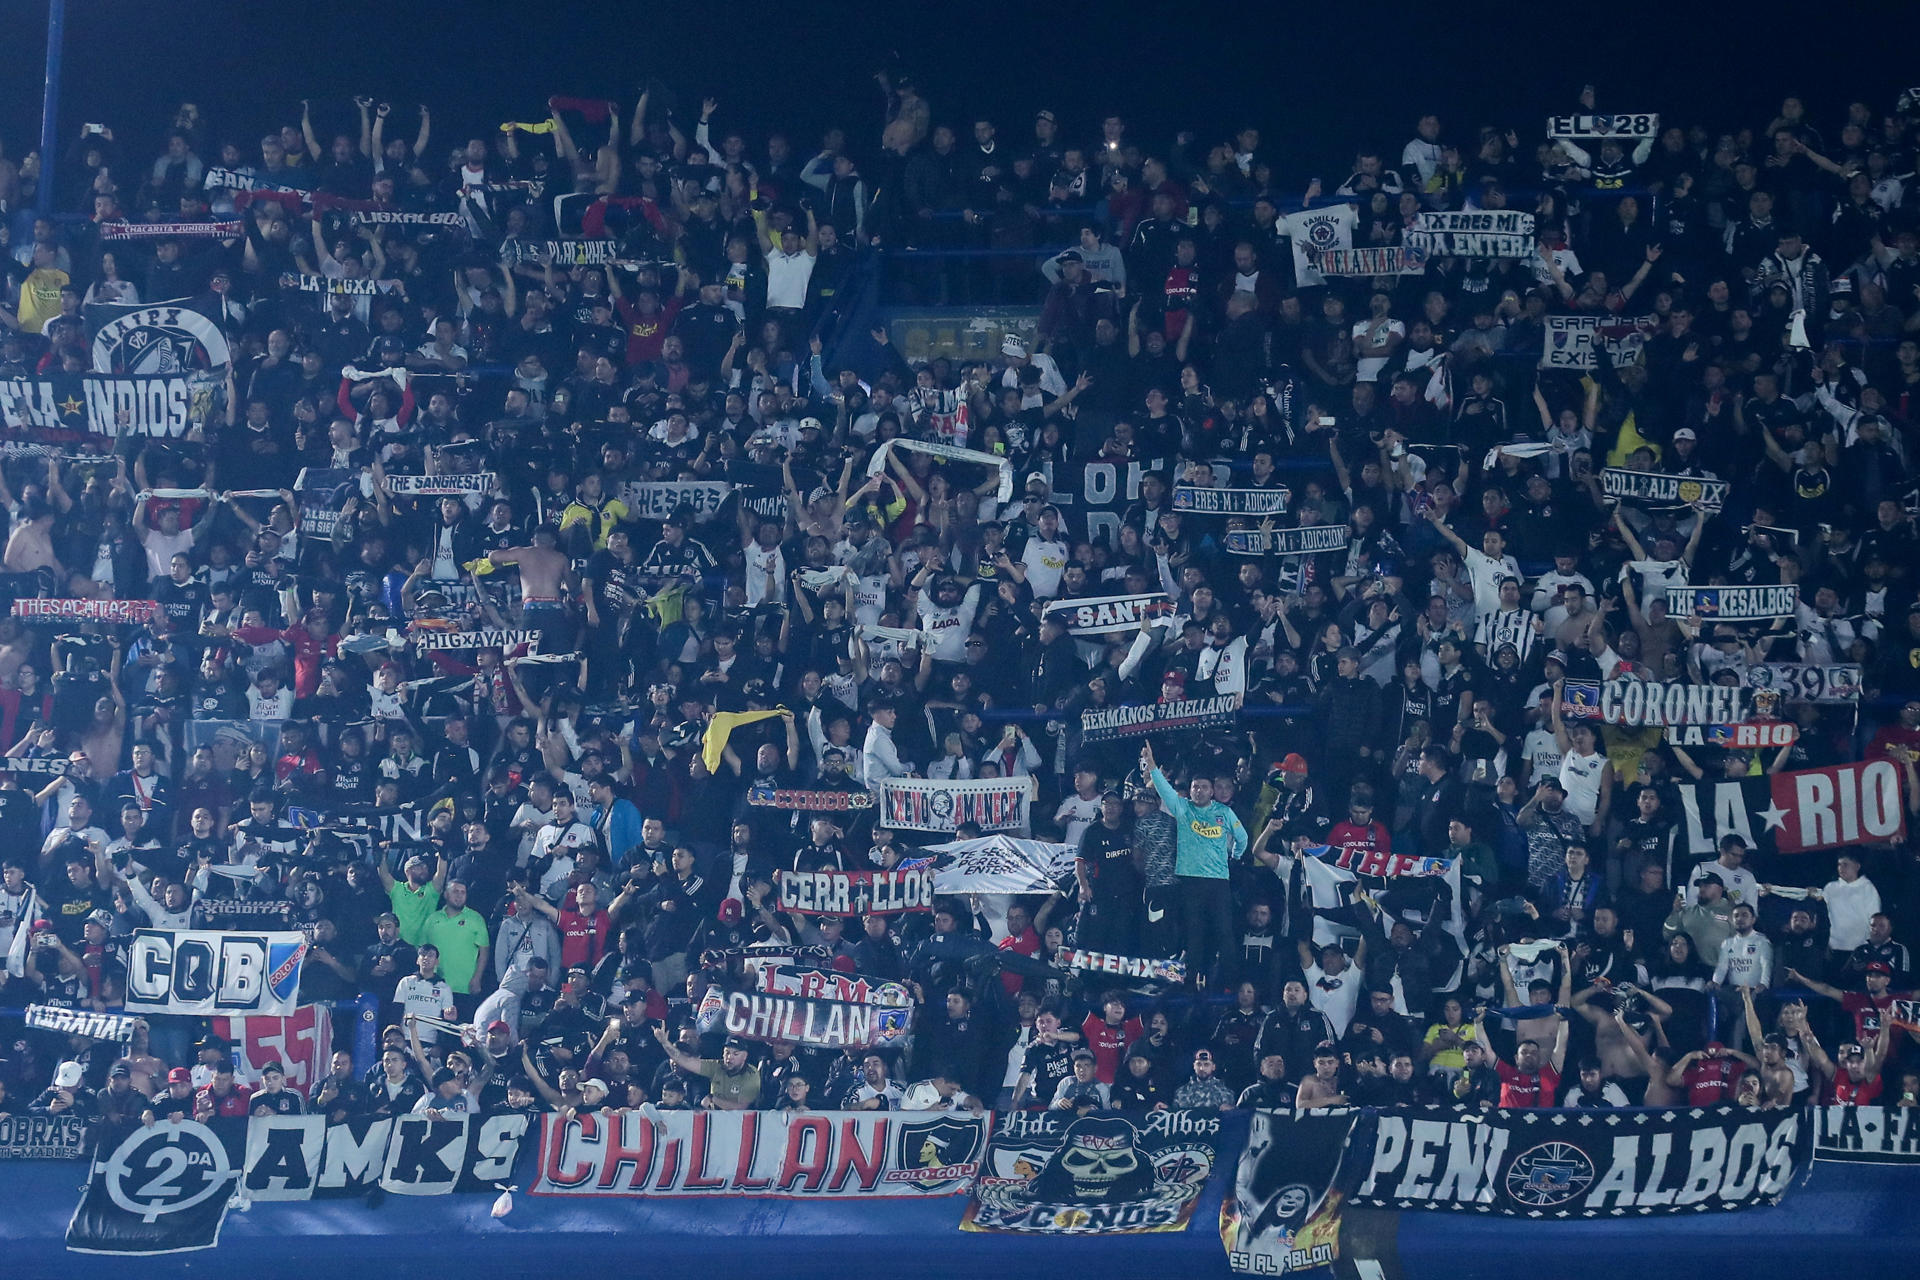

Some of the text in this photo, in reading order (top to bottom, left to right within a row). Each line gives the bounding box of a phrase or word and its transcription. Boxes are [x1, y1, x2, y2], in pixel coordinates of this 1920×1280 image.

[1553, 115, 1650, 135] EL 28
[125, 225, 217, 234] CHACARITA JUNIORS
[1302, 215, 1341, 228] FAMILIA
[1449, 213, 1494, 230] ERES
[1496, 213, 1520, 232] MI
[1452, 232, 1535, 258] ENTERA
[300, 275, 320, 294] LA
[83, 378, 188, 438] INDIOS
[388, 475, 411, 492] THE
[1195, 491, 1218, 510] ERES
[1244, 491, 1286, 512] ADICCION
[1301, 527, 1345, 550] ADICCION
[1666, 587, 1796, 617] THE KESALBOS
[931, 616, 961, 630] LADA
[1782, 664, 1826, 702] 39
[1081, 703, 1155, 731] HERMANOS
[1165, 695, 1236, 719] ARELLANO
[1601, 680, 1748, 726] CORONEL
[1668, 726, 1793, 746] LA RIO
[1679, 759, 1902, 855] LA RIO
[959, 851, 977, 860] TE
[725, 991, 872, 1045] CHILLAN
[1046, 1056, 1069, 1072] Pilsen
[1055, 1065, 1069, 1078] Sur
[1138, 1109, 1221, 1138] Albos
[1584, 1112, 1799, 1210] ALBOS
[1230, 1251, 1249, 1269] ES
[1255, 1253, 1278, 1273] AL
